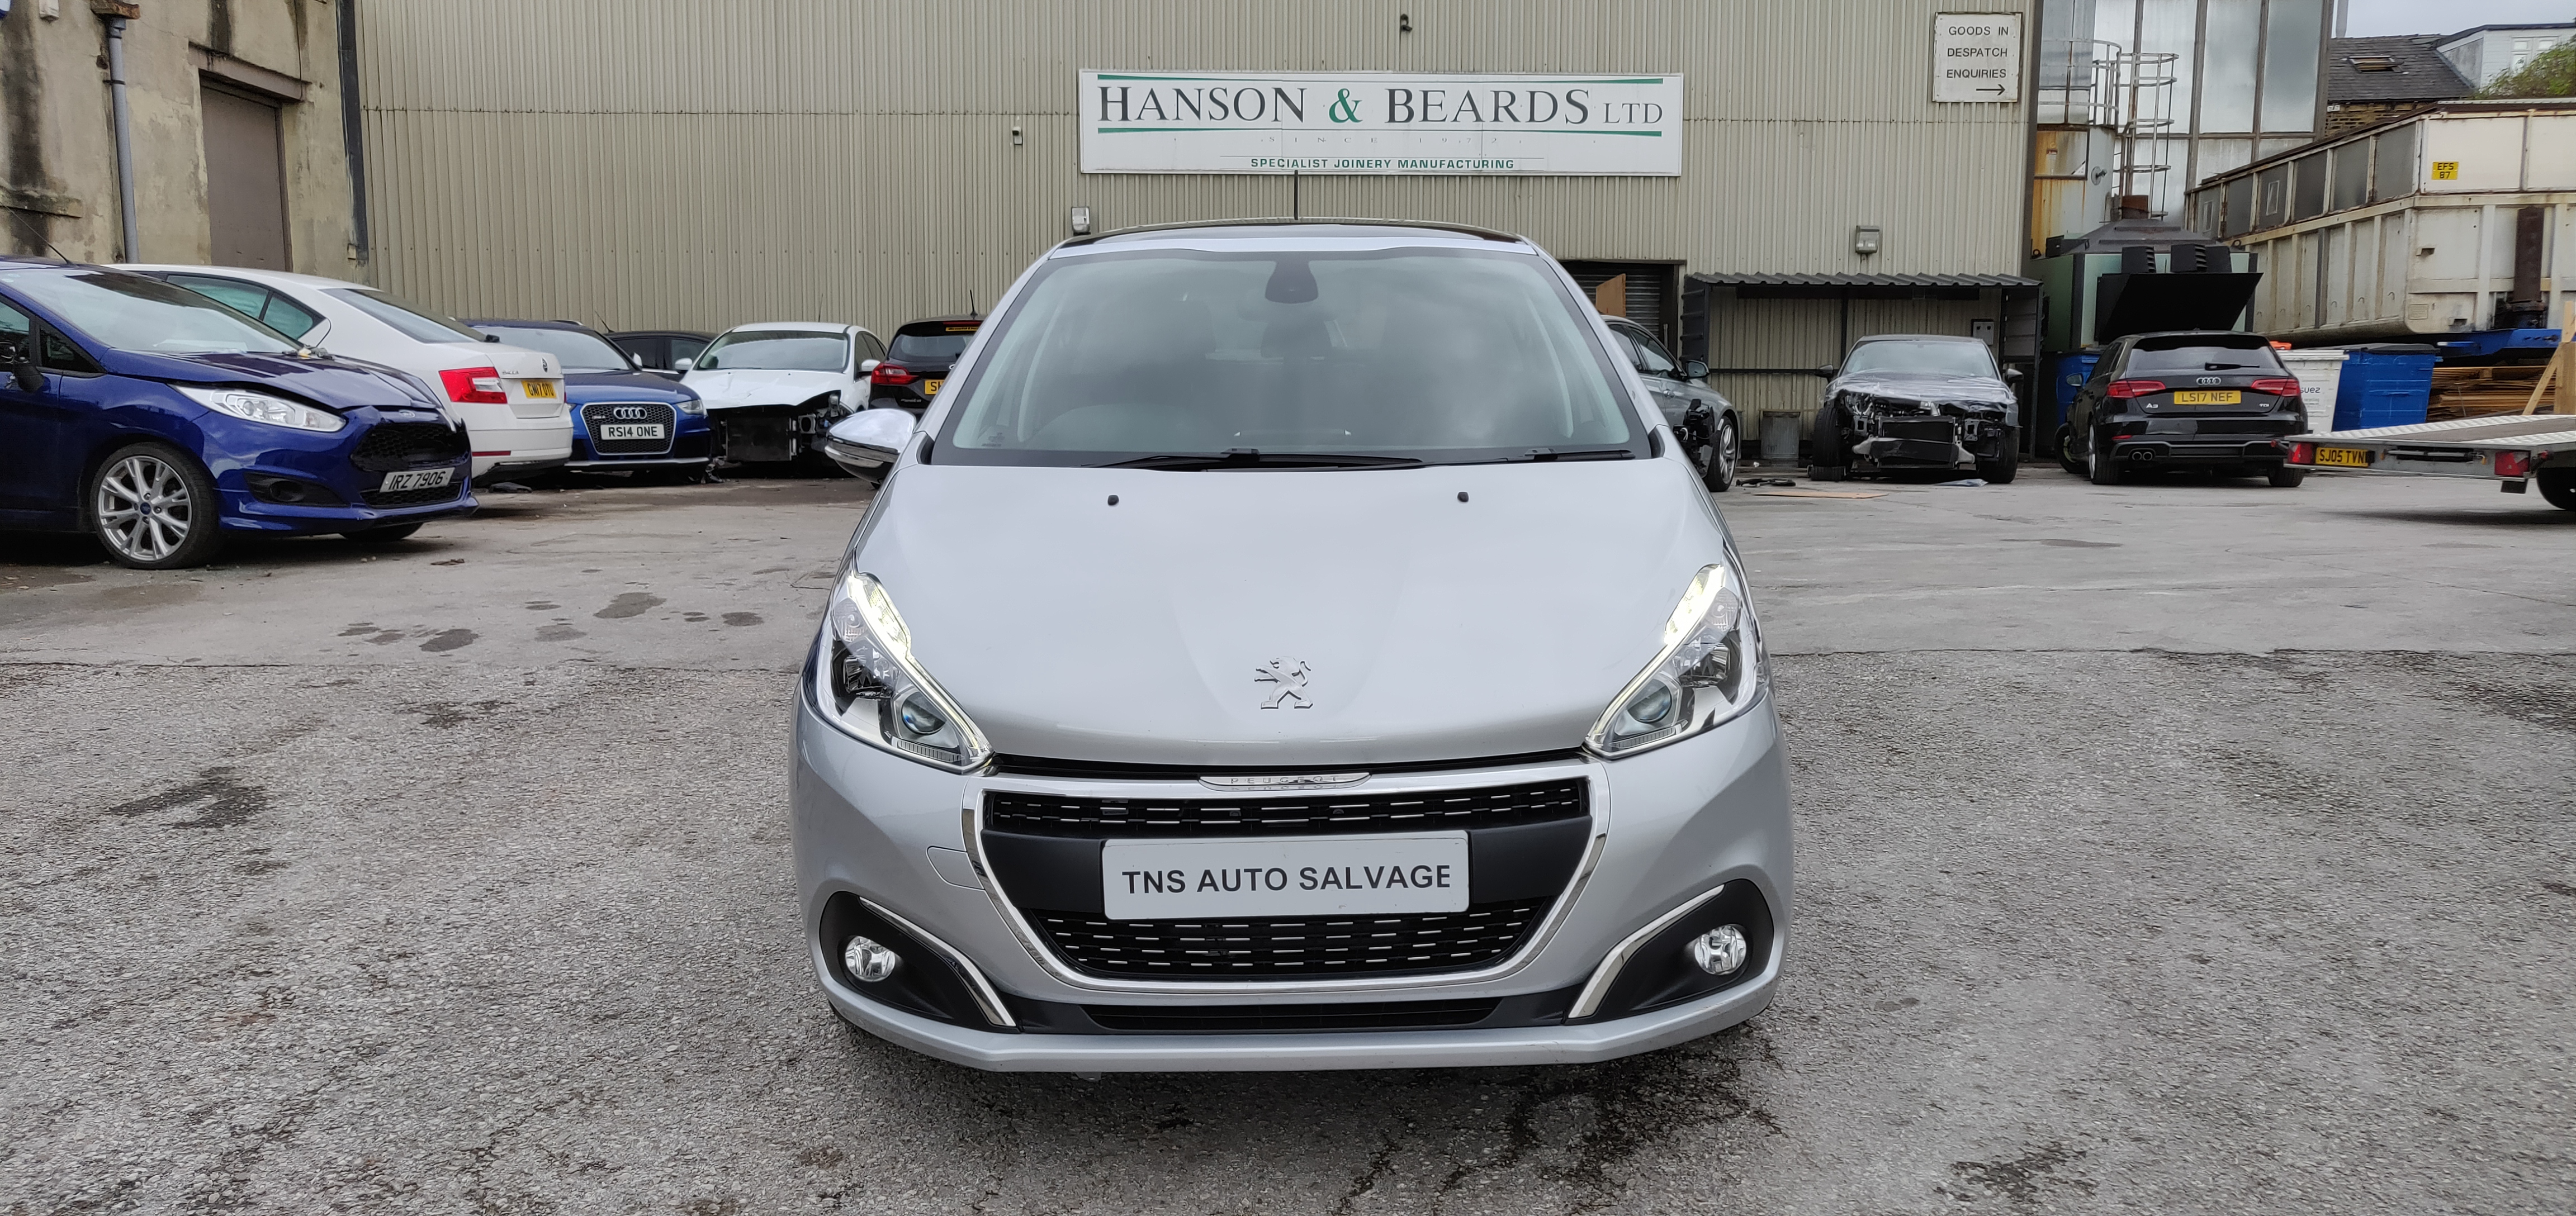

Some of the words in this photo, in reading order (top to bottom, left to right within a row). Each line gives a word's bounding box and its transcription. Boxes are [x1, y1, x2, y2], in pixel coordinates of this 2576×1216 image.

[1949, 26, 1991, 36] GOODS
[1999, 26, 2009, 36] IN
[1948, 48, 2007, 57] DESPATCH
[1947, 69, 2006, 78] ENQUIRIES
[1097, 86, 1308, 123] HANSON
[1328, 88, 1363, 124] &
[1385, 88, 1590, 125] BEARDS
[1602, 102, 1663, 124] LTD
[1251, 158, 1328, 168] SPECIALIST
[1334, 159, 1392, 169] JOINERY
[1398, 159, 1515, 169] MANUFACTURING
[2181, 393, 2207, 402] LS17
[2211, 392, 2233, 402] NEF
[608, 426, 633, 438] RS14
[637, 426, 658, 437] ONE
[2319, 449, 2343, 463] SJ05
[2346, 450, 2364, 464] TVN
[389, 474, 414, 490] IRZ
[412, 471, 446, 488] 7906
[1230, 775, 1340, 784] PEUGEOT
[1121, 870, 1186, 894] TNS
[1196, 867, 1288, 892] AUTO
[1299, 864, 1451, 891] SALVAGE
